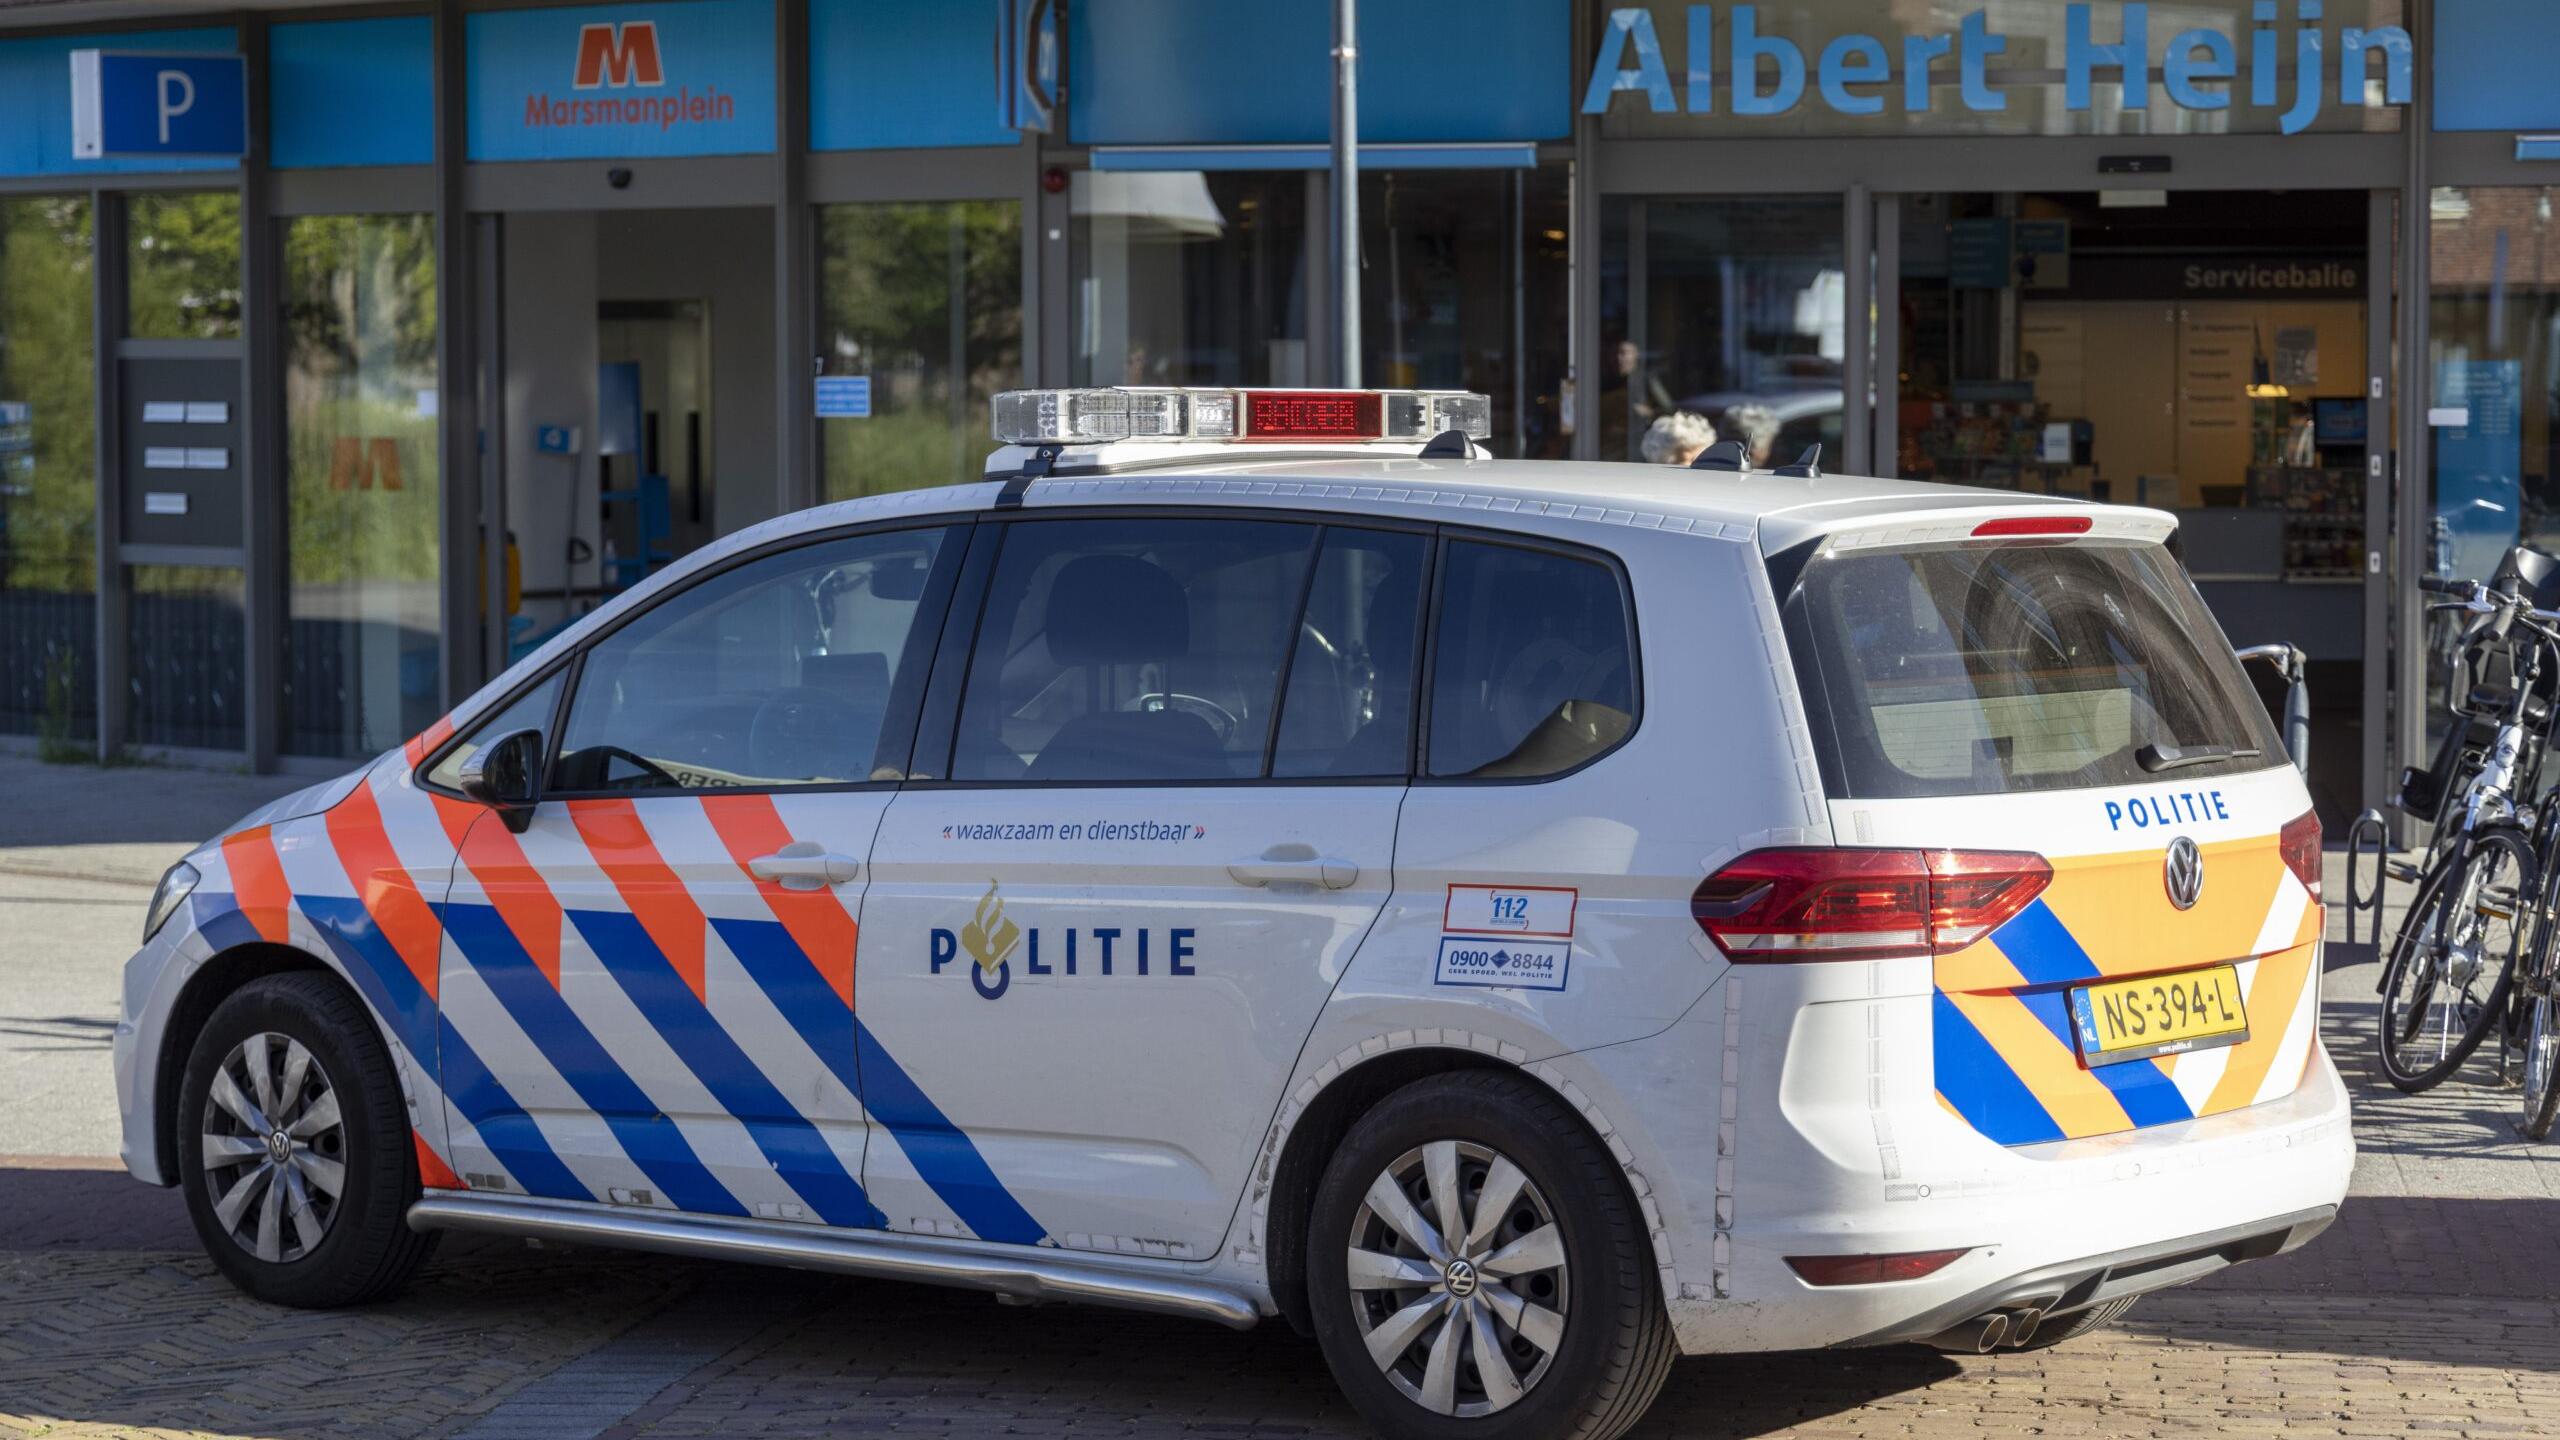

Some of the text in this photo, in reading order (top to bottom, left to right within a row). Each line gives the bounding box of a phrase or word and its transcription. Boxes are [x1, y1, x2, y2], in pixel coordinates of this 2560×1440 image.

[572, 20, 665, 90] M
[1581, 0, 2413, 135] Albert Heijn
[157, 69, 195, 144] P
[523, 85, 735, 133] Marsmanplein
[2184, 263, 2357, 289] Servicebalie
[2104, 790, 2229, 831] POLITIE
[1059, 824, 1082, 841] en
[1449, 950, 1554, 971] 0900 8844
[1520, 971, 1553, 979] POLITIE
[2102, 978, 2235, 1040] NS-394-L
[2082, 1029, 2097, 1043] NL
